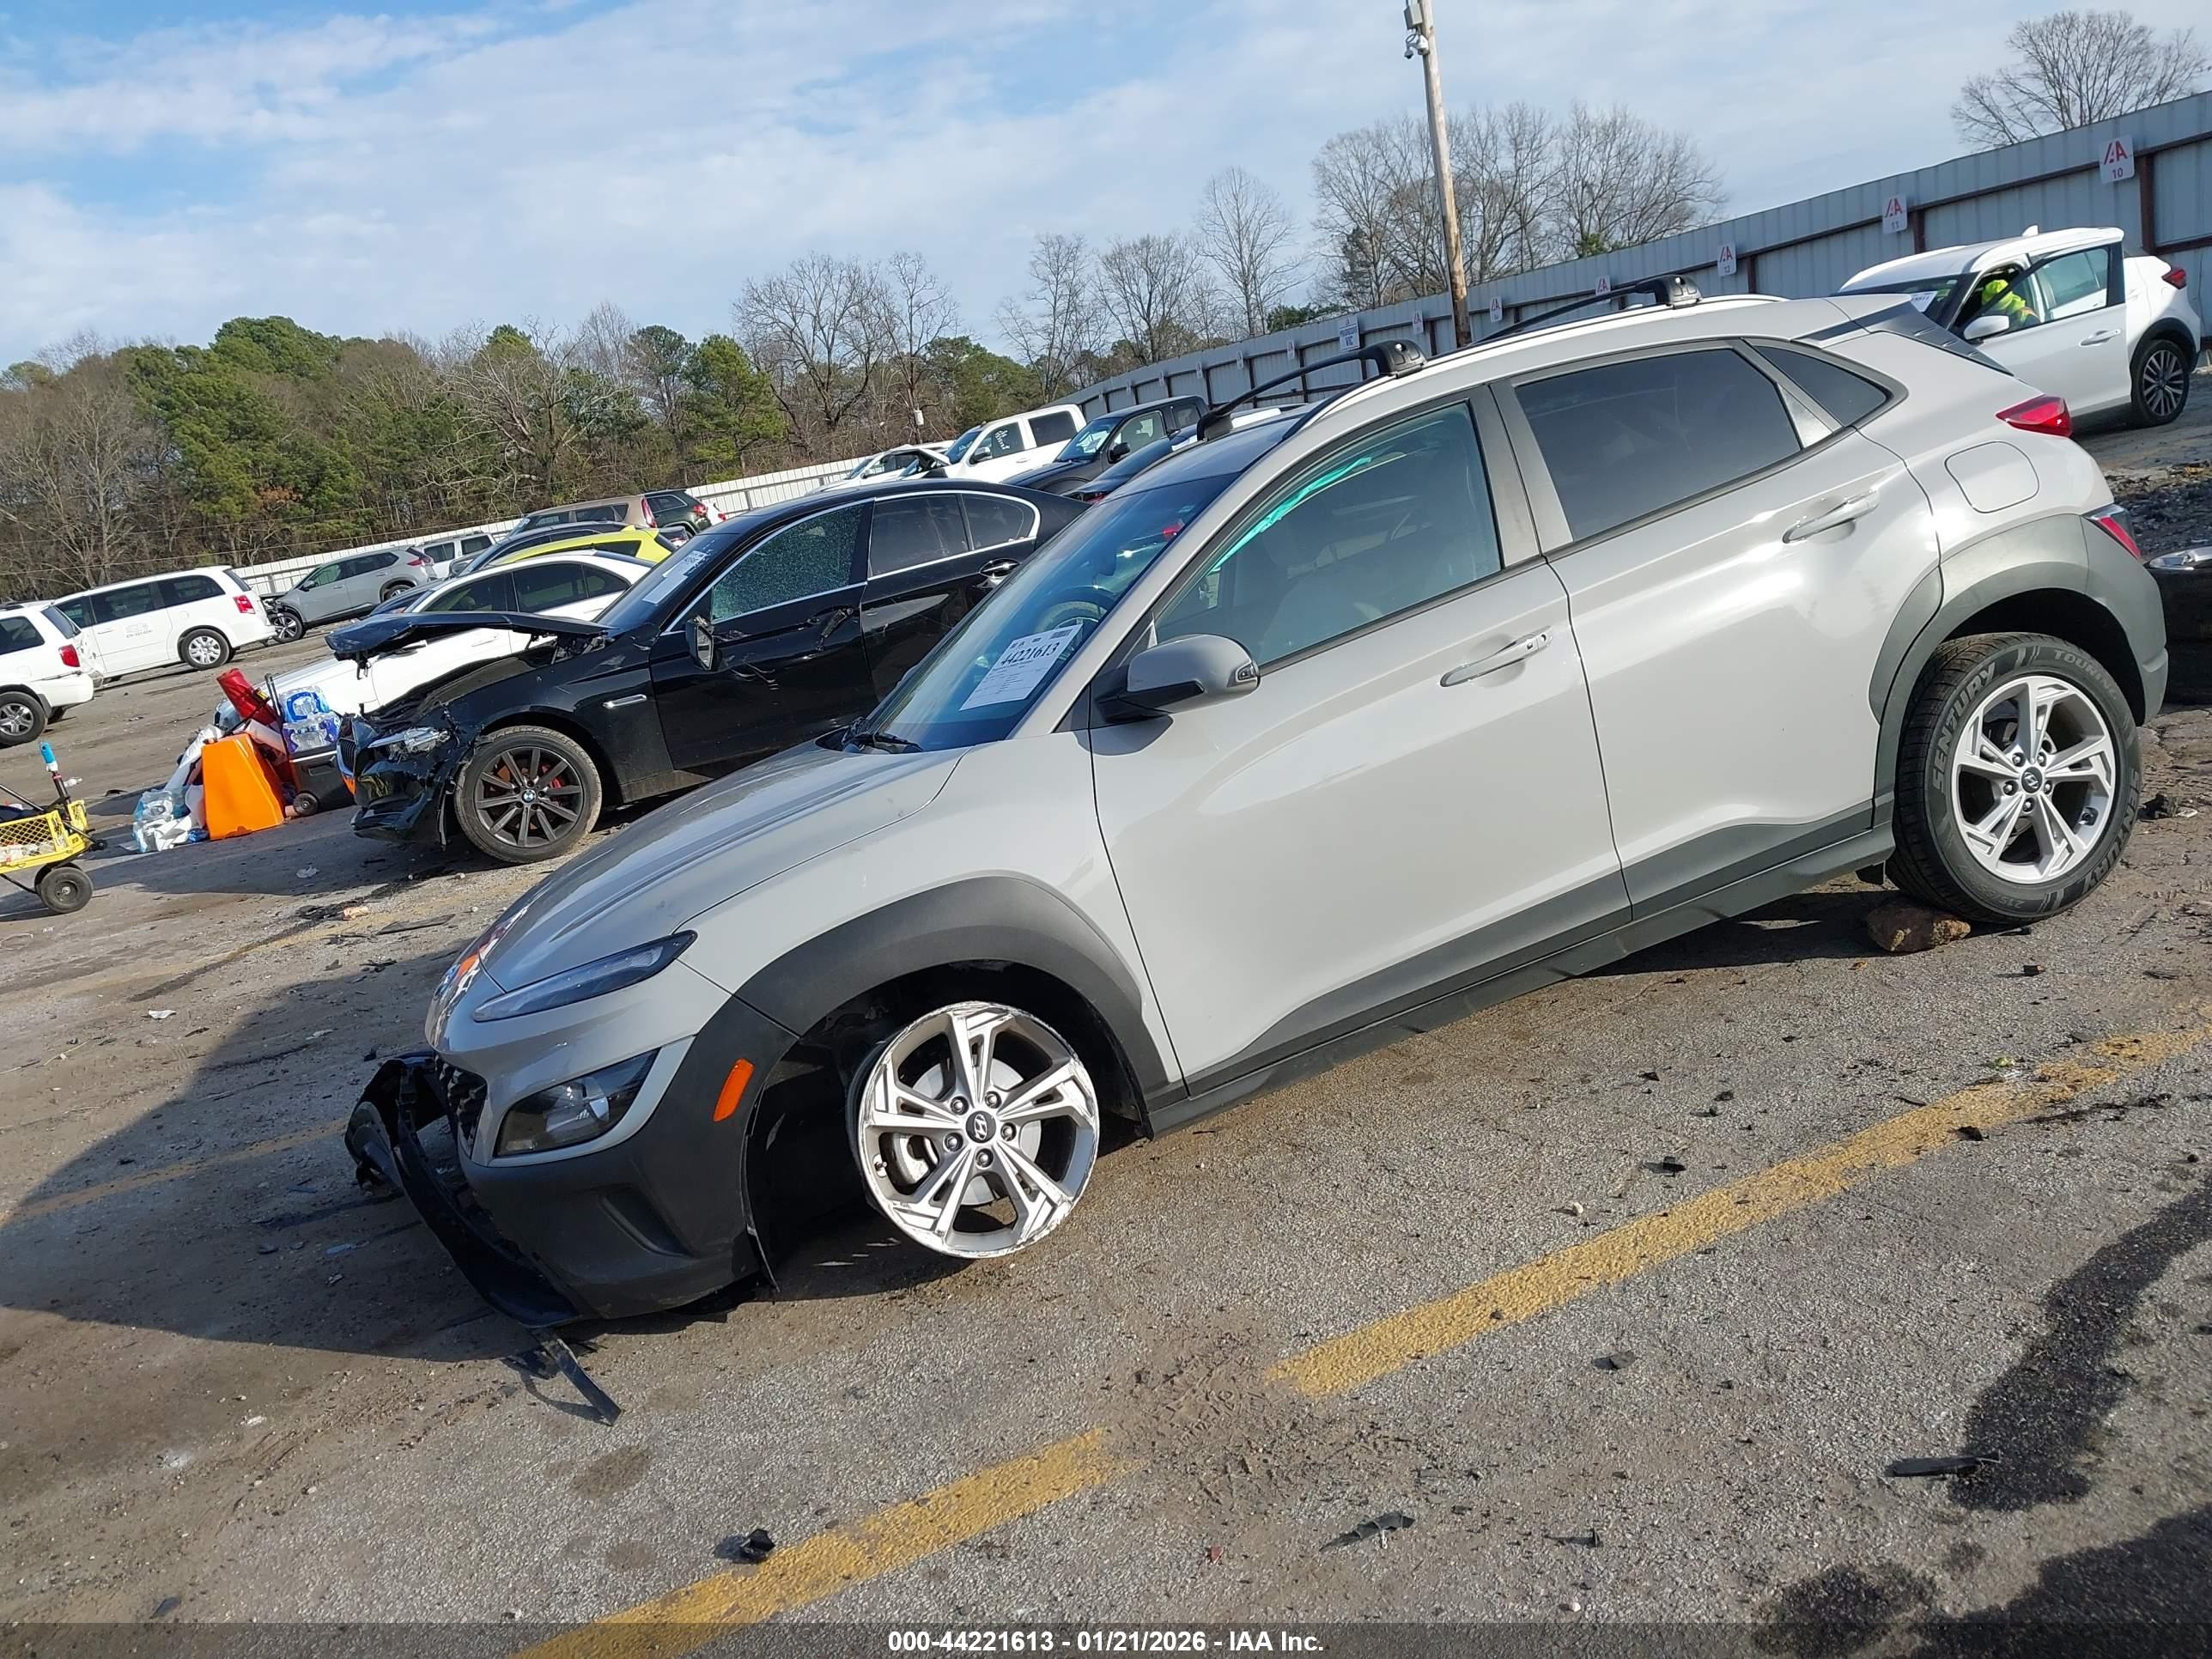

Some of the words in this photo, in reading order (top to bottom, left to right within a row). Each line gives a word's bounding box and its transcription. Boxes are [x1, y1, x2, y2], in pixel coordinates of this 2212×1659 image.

[2112, 167, 2124, 179] 10
[1000, 641, 1060, 665] 44221613
[2053, 649, 2118, 700] TOURING
[1932, 662, 1996, 793] SENTURY
